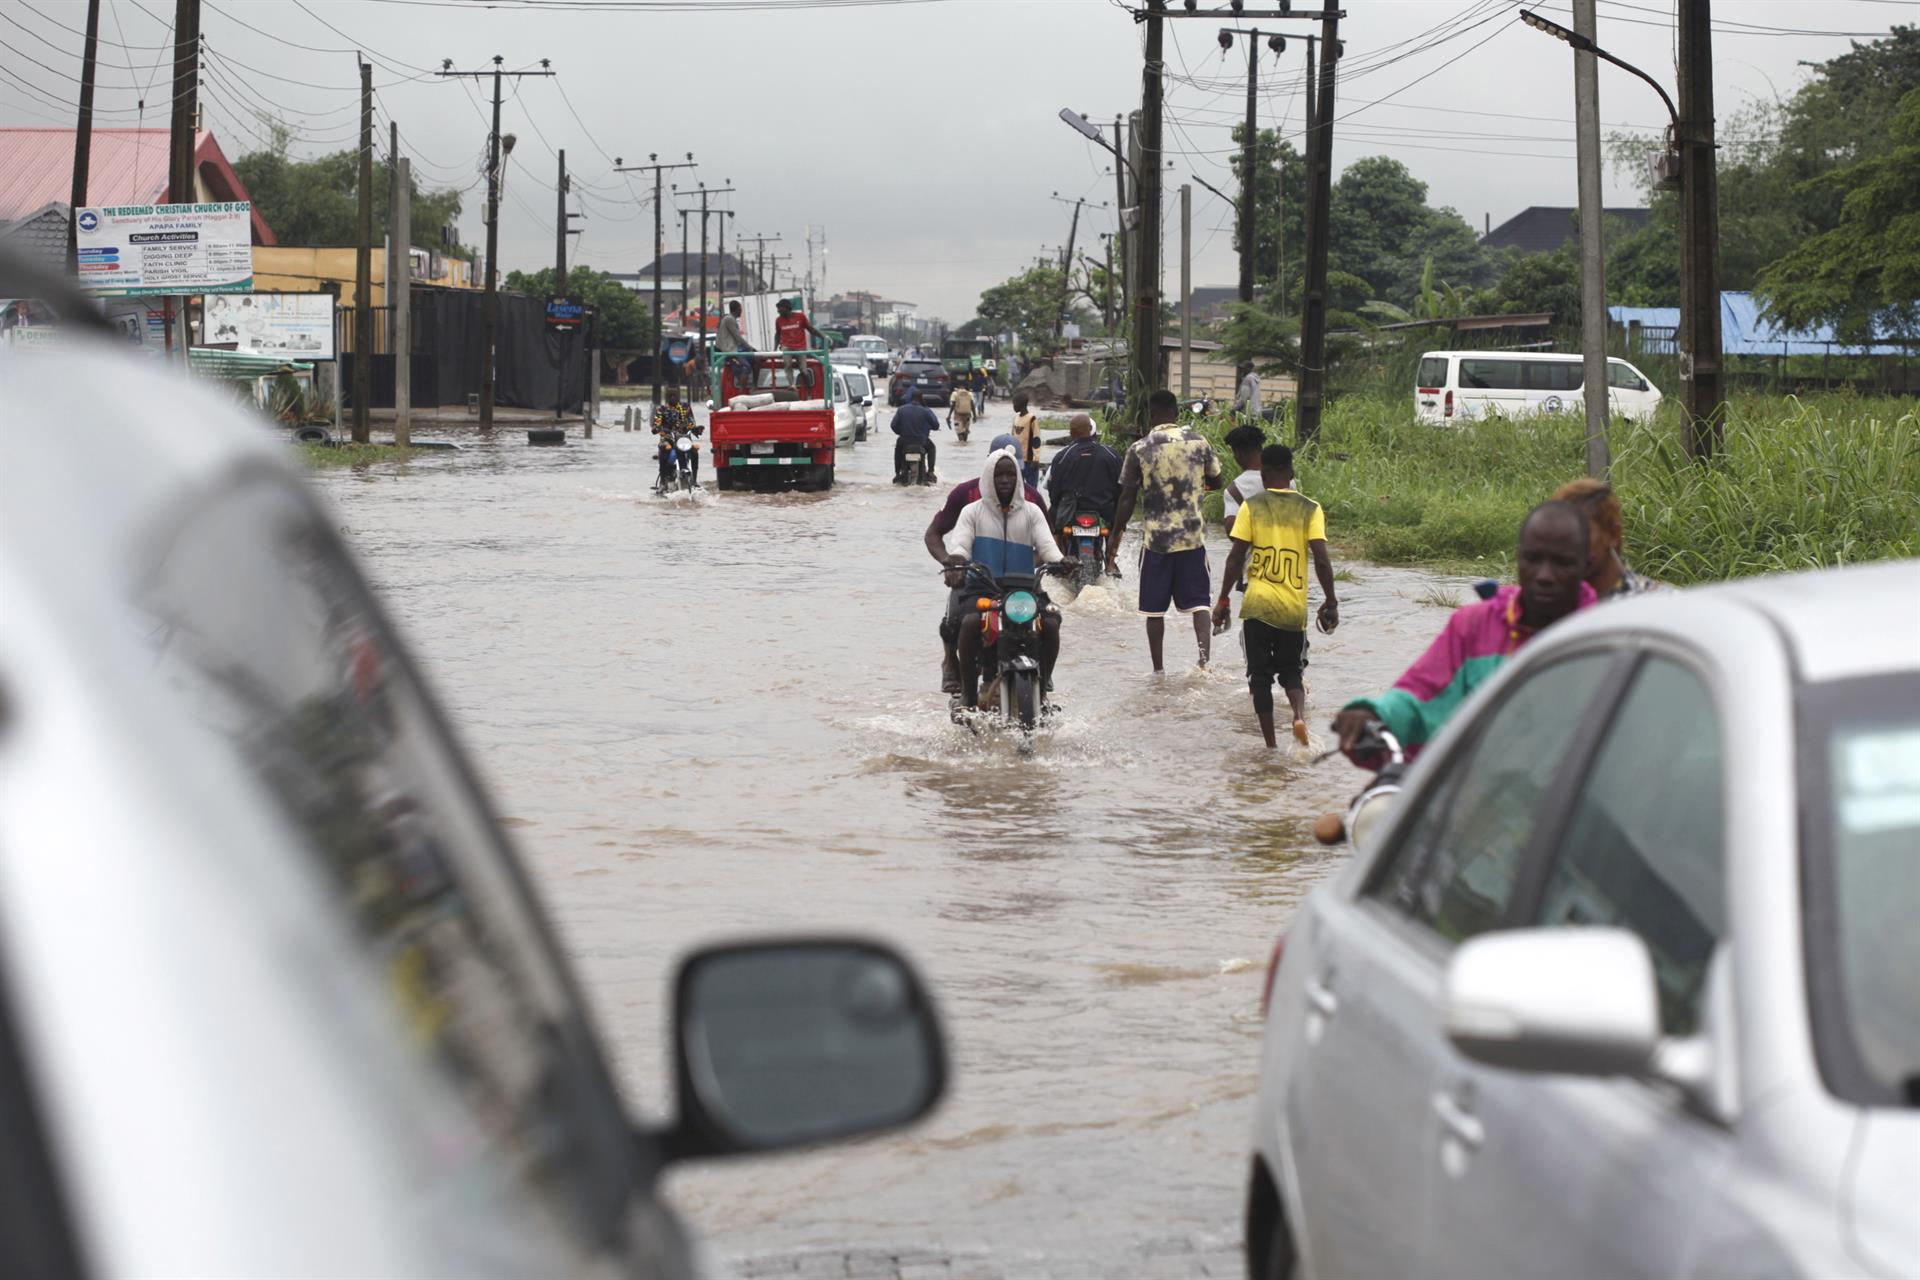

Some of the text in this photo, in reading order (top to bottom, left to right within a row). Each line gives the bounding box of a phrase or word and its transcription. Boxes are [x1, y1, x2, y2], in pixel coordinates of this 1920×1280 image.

[103, 207, 116, 216] THE
[118, 206, 154, 216] REDEEMED
[156, 204, 192, 215] CHRISTIAN
[194, 203, 221, 213] CHURCH
[224, 203, 233, 212] OF
[161, 233, 196, 241] Activities
